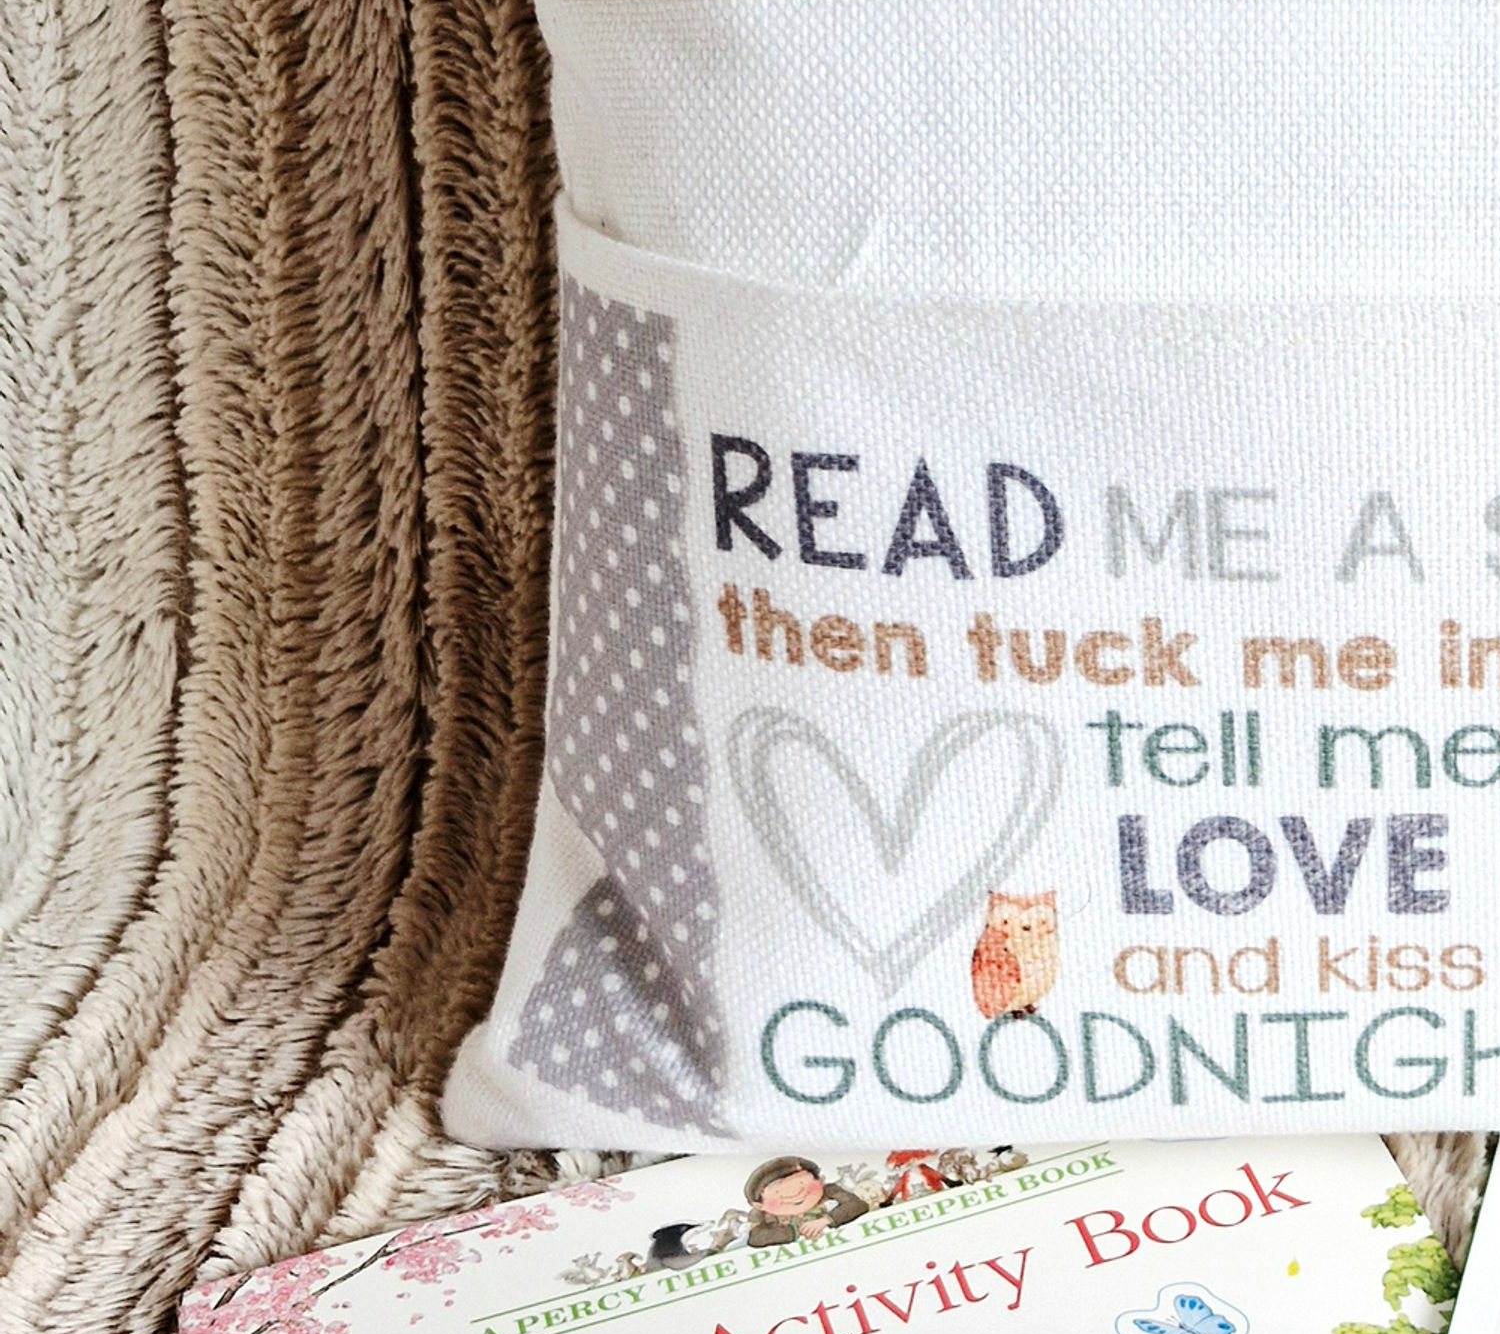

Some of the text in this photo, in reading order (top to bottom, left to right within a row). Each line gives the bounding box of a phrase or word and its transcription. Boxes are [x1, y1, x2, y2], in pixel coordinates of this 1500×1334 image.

[710, 433, 1066, 581] READ
[1104, 485, 1279, 582] ME
[1334, 490, 1425, 584] A
[717, 582, 927, 679] then
[967, 611, 1202, 687] tuck
[1241, 634, 1397, 692] me
[1086, 709, 1261, 788] tell
[1116, 812, 1451, 915] LOVE
[1112, 936, 1280, 995] and
[1317, 935, 1487, 993] kiss
[658, 1259, 738, 1296] THE
[750, 1228, 851, 1269] PARK
[860, 1181, 1008, 1238] KEEPER
[1016, 1149, 1119, 1192] BOOK
[1064, 1162, 1312, 1269] Book
